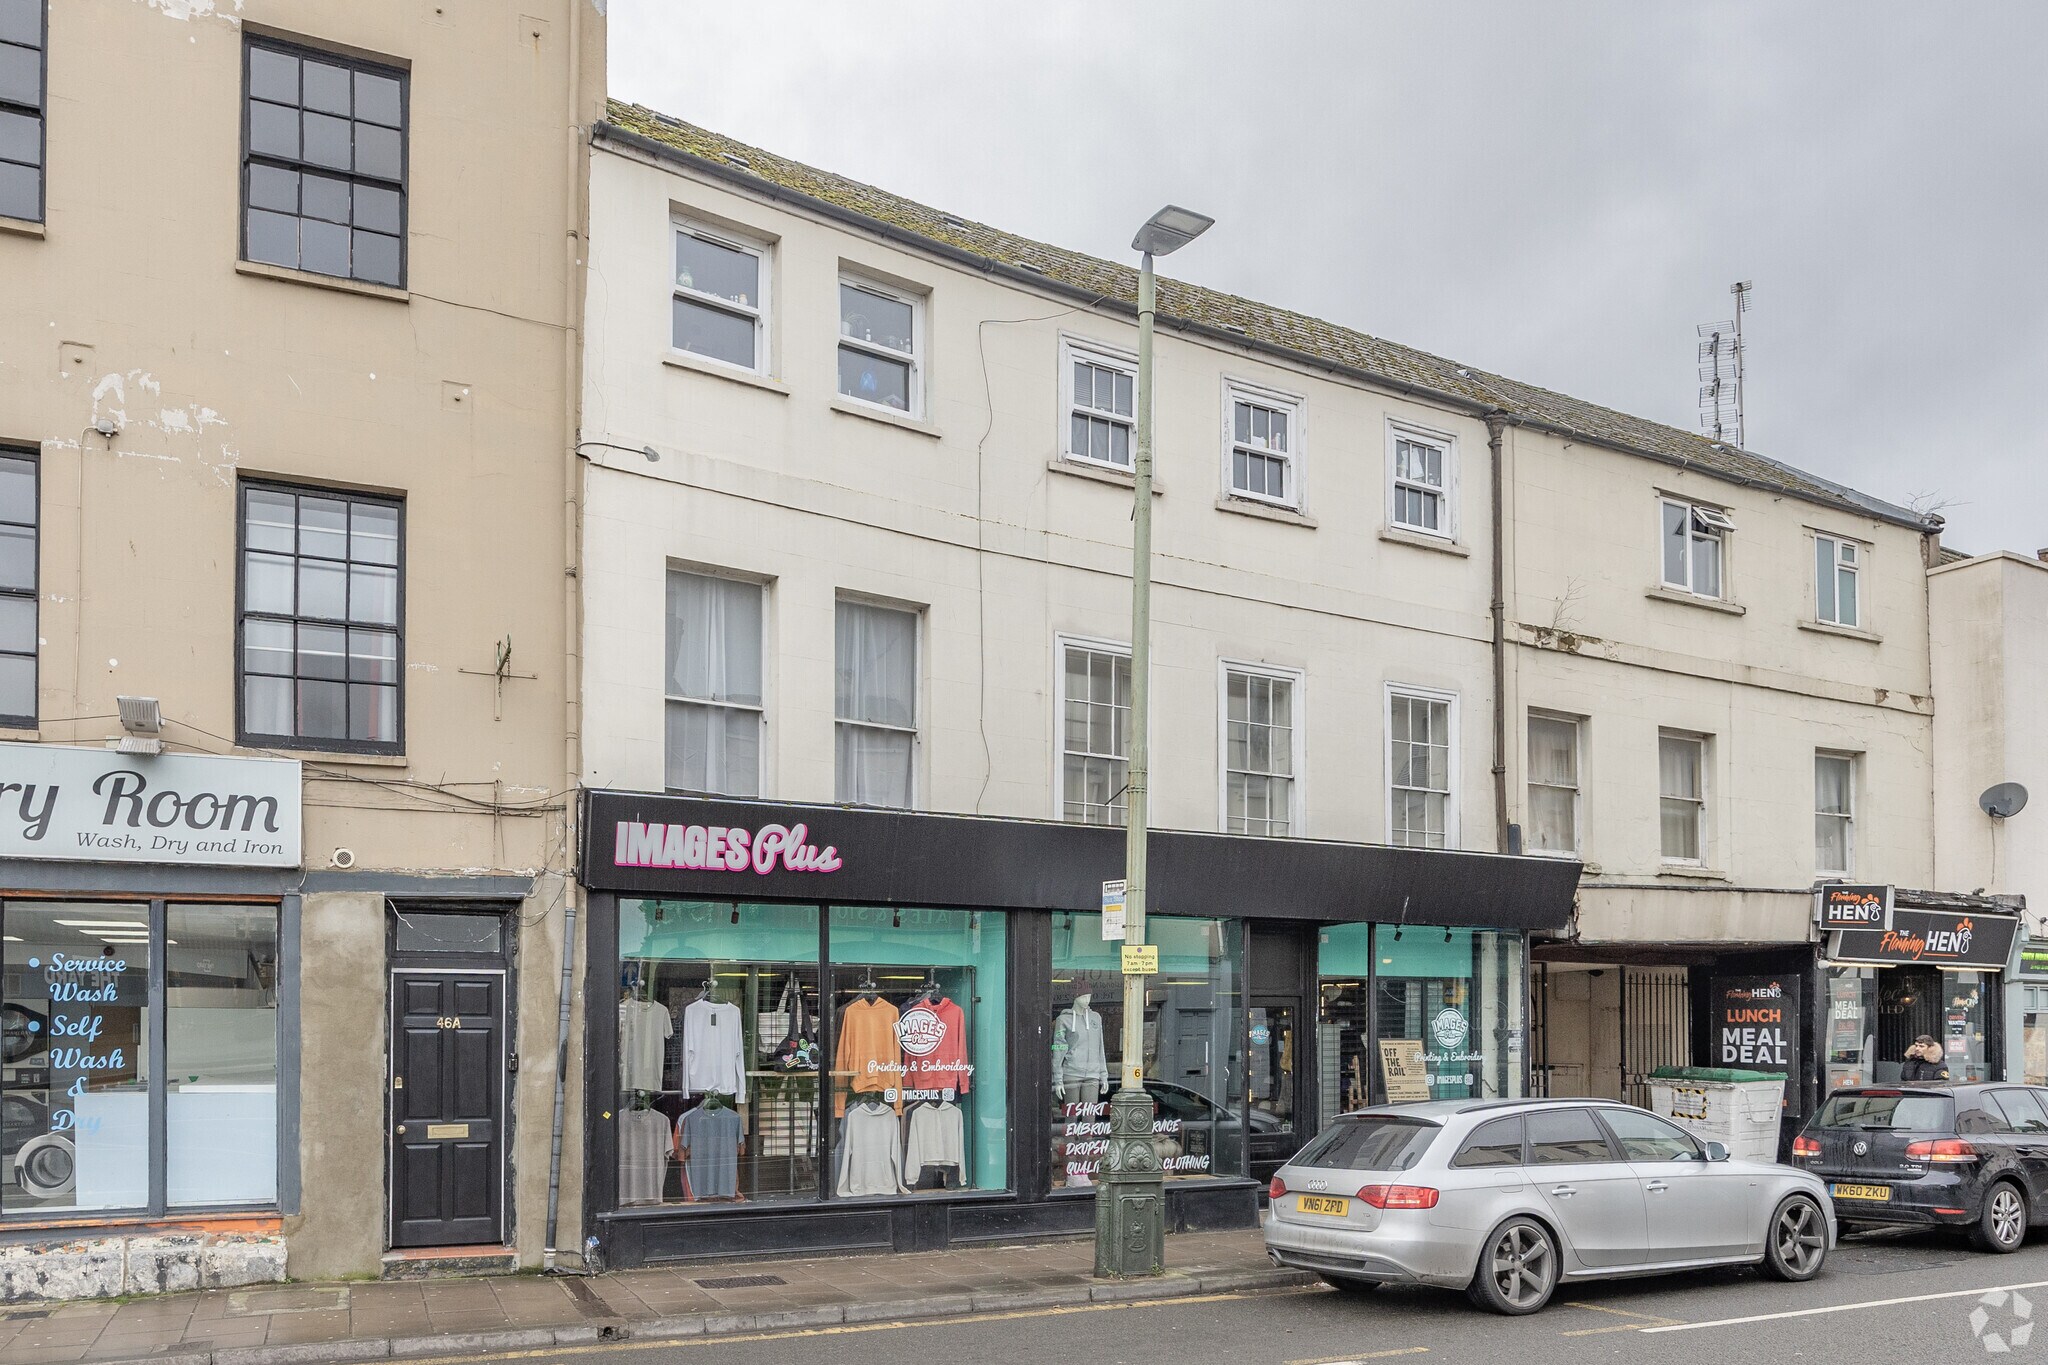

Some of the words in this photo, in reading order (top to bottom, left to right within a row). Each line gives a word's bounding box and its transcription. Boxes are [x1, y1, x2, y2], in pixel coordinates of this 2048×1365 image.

[92, 770, 280, 833] Room
[77, 832, 142, 851] Wash,
[152, 835, 189, 855] Dry
[196, 839, 237, 853] and
[242, 840, 284, 855] Iron
[615, 821, 751, 871] IMAGES
[751, 823, 843, 875] Plus
[1830, 891, 1861, 905] Flaming
[1829, 904, 1869, 920] HEN
[1900, 929, 1910, 937] THE
[1880, 931, 1925, 960] Flaming
[1925, 930, 1962, 952] HEN
[50, 953, 127, 972] Service
[50, 982, 118, 1002] Wash
[1752, 988, 1775, 998] HEN
[1835, 1000, 1858, 1010] MEAL
[436, 1016, 461, 1029] 46A
[1727, 1008, 1782, 1023] LUNCH
[1835, 1010, 1858, 1020] DEAL
[50, 1015, 103, 1043] Self
[895, 1019, 945, 1037] IMAGES
[1432, 1018, 1468, 1033] IMAGES
[1722, 1027, 1787, 1046] MEAL
[50, 1048, 126, 1069] Wash
[1385, 1058, 1401, 1067] THE
[1414, 1051, 1442, 1066] Printing
[1443, 1052, 1449, 1062] &
[1722, 1045, 1788, 1065] DEAL
[867, 1059, 908, 1077] Printing
[910, 1060, 918, 1072] &
[921, 1059, 975, 1077] Embroidery
[1134, 1068, 1141, 1078] 6
[67, 1076, 88, 1097] &
[901, 1089, 940, 1100] IMAGESPLUS
[1075, 1101, 1109, 1117] SHIRT
[51, 1109, 104, 1135] Dry
[1163, 1154, 1210, 1170] CLOTHING
[1836, 1184, 1863, 1197] WK60
[1865, 1186, 1888, 1199] ZKU
[1303, 1197, 1323, 1211] VN61
